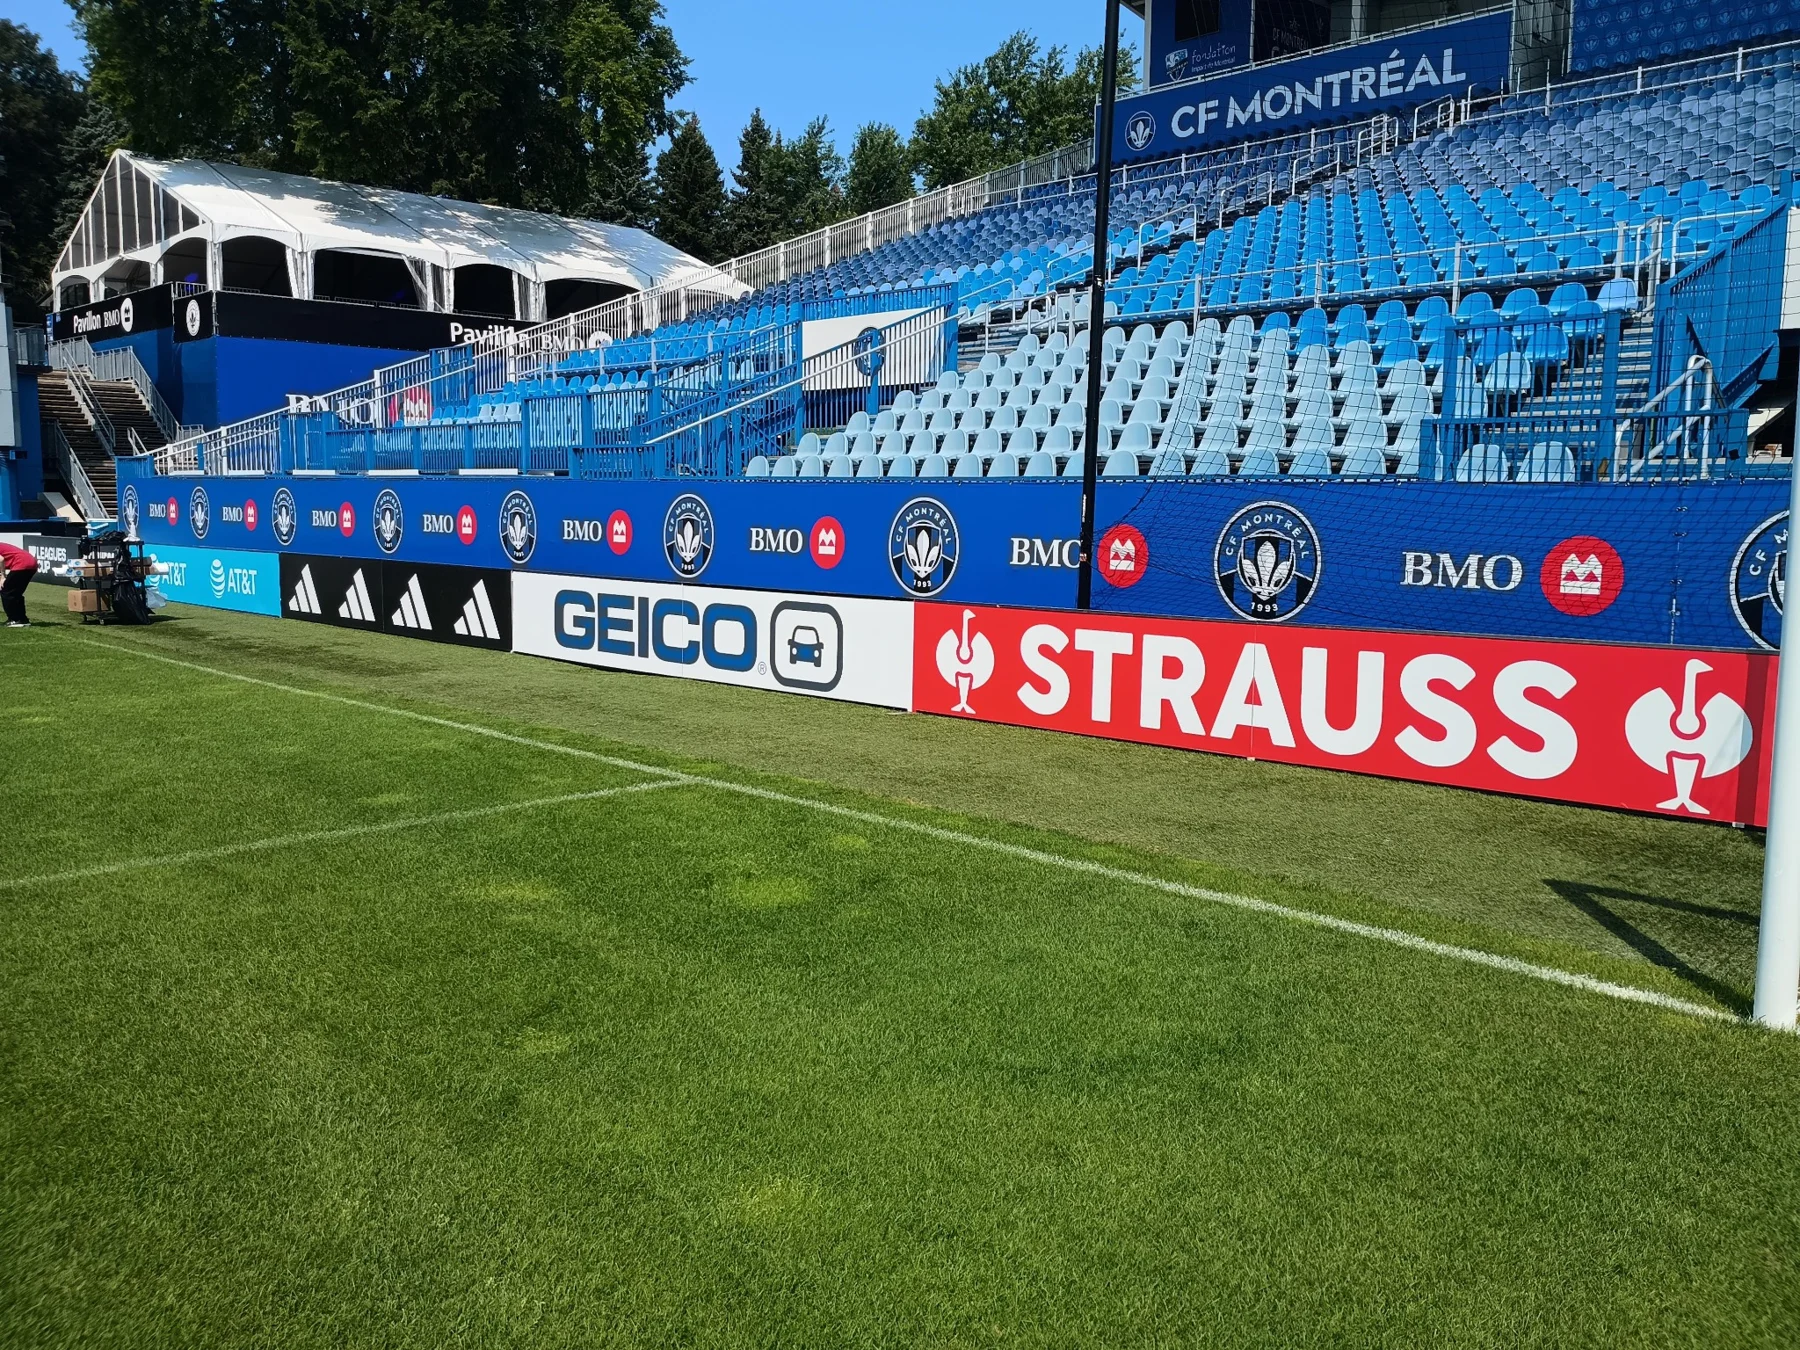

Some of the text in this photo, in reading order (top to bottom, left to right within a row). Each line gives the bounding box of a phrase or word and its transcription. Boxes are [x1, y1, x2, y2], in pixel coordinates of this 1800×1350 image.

[1191, 42, 1236, 64] fondation
[1171, 48, 1467, 138] CF MONTRÉAL
[73, 309, 120, 333] Pavillon BMO
[149, 503, 166, 518] BMO
[222, 506, 243, 522] BMO
[312, 510, 337, 527] BMO
[675, 502, 709, 534] MONTRÉAL
[422, 514, 454, 534] BMO
[562, 519, 602, 543] BMO
[896, 507, 952, 545] CF MONTRÉAL
[1225, 513, 1310, 559] CF MONTRÉAL
[749, 527, 804, 554] BMO
[36, 546, 67, 562] LEAGUES
[227, 568, 257, 595] AT&T
[913, 579, 932, 587] 1993
[1400, 551, 1523, 592] BMO
[1251, 602, 1279, 612] 1993
[554, 589, 758, 673] GEICO
[1016, 623, 1579, 780] STRAUSS
